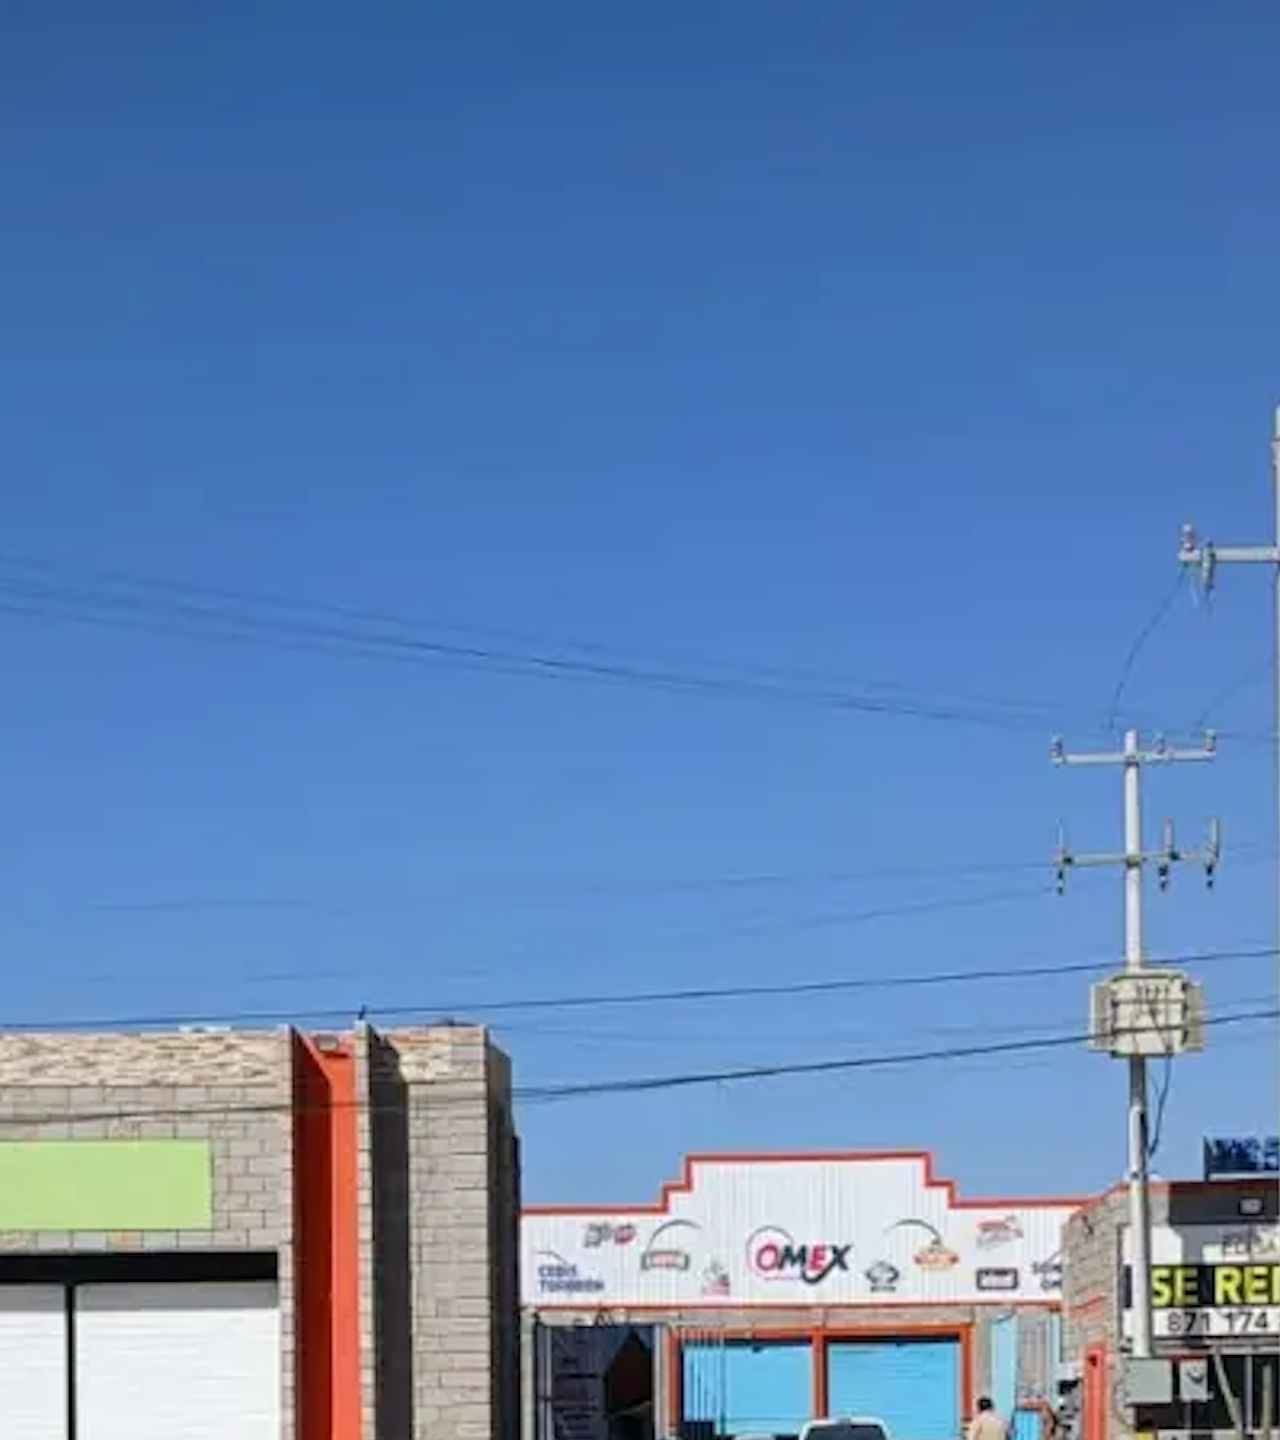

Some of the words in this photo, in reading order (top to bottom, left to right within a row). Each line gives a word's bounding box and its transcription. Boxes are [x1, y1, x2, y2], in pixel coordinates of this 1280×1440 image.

[755, 1243, 853, 1284] OMEX
[1152, 1267, 1198, 1306] SE
[1167, 1311, 1211, 1333] 871
[1225, 1311, 1268, 1331] 174
